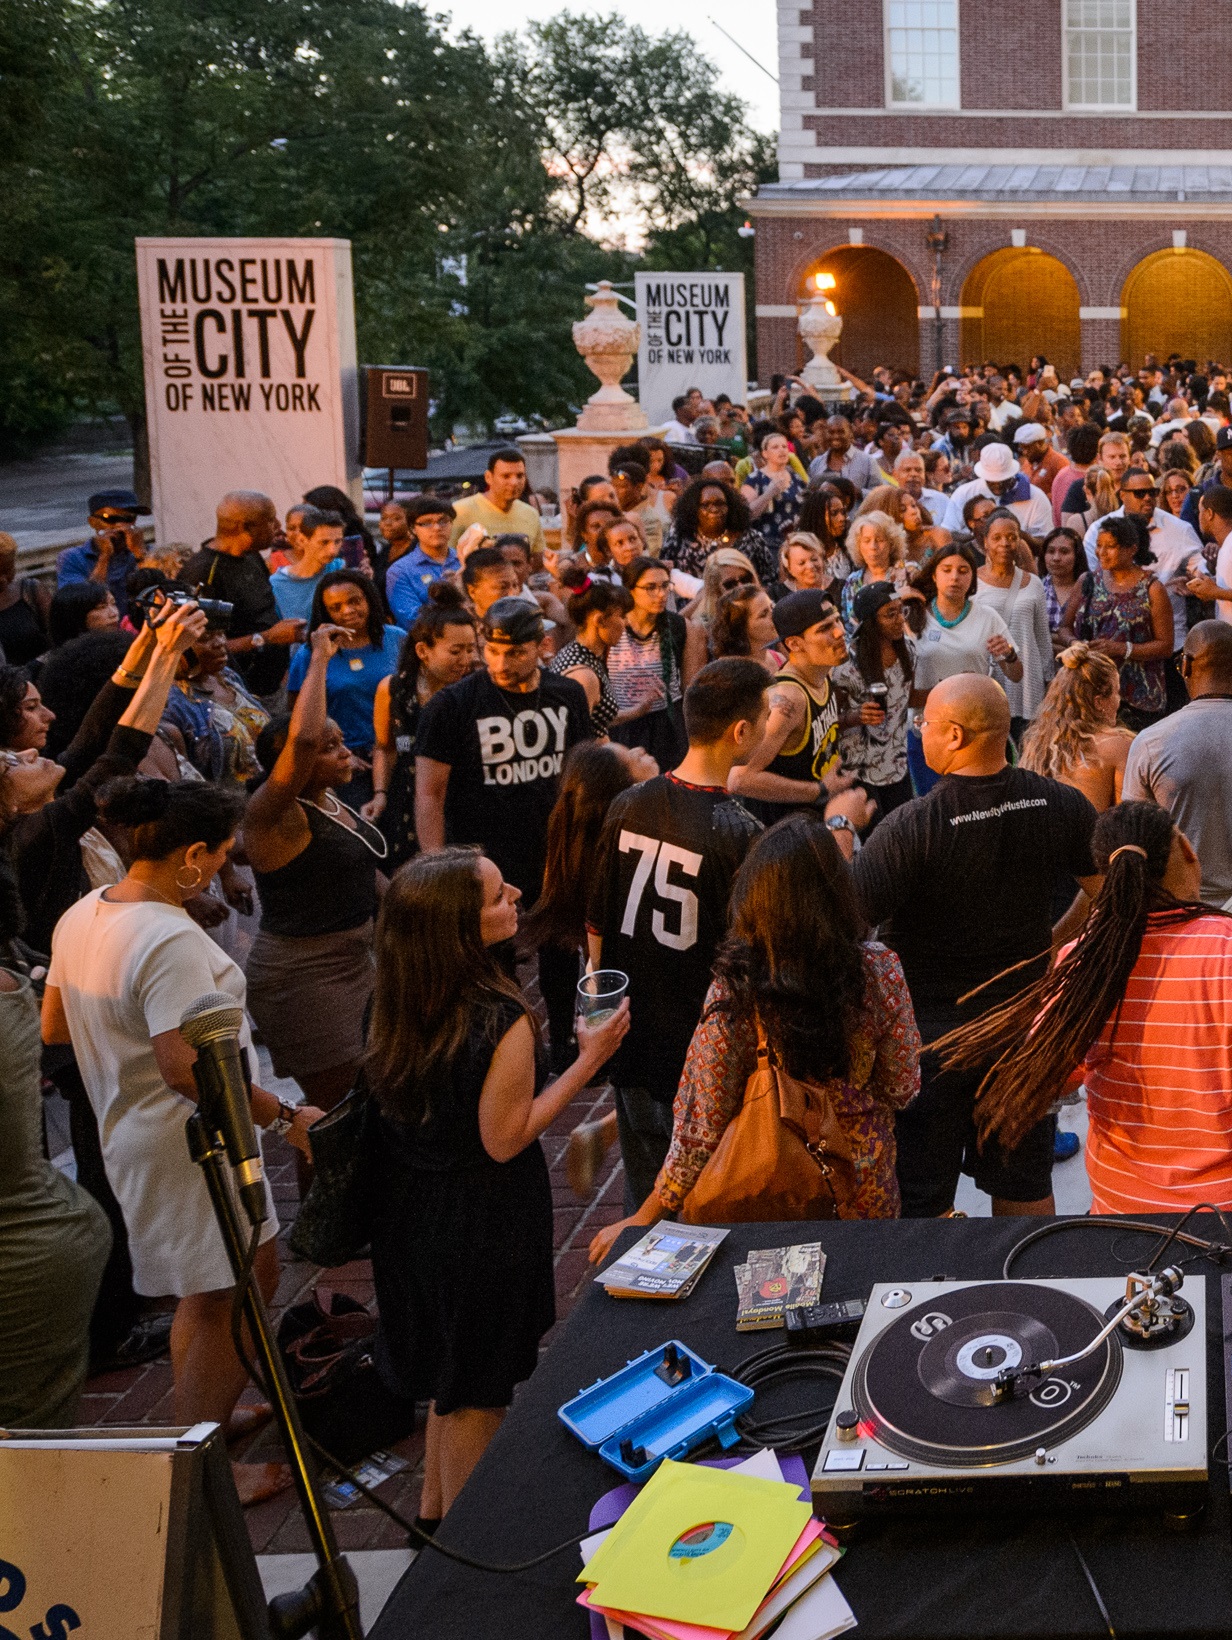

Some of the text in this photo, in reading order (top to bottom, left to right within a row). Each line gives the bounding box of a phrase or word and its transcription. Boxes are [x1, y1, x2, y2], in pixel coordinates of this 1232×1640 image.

[156, 258, 316, 304] MUSEUM
[646, 283, 729, 308] MUSEUM
[160, 308, 192, 378] OF THE
[193, 308, 316, 379] CITY
[647, 308, 662, 347] OF THE
[665, 310, 729, 347] CITY
[648, 349, 731, 364] OF NEW YORK
[165, 383, 322, 412] OF NEW YORK
[476, 705, 568, 765] BOY
[482, 752, 563, 785] LONDON
[618, 828, 704, 951] 75
